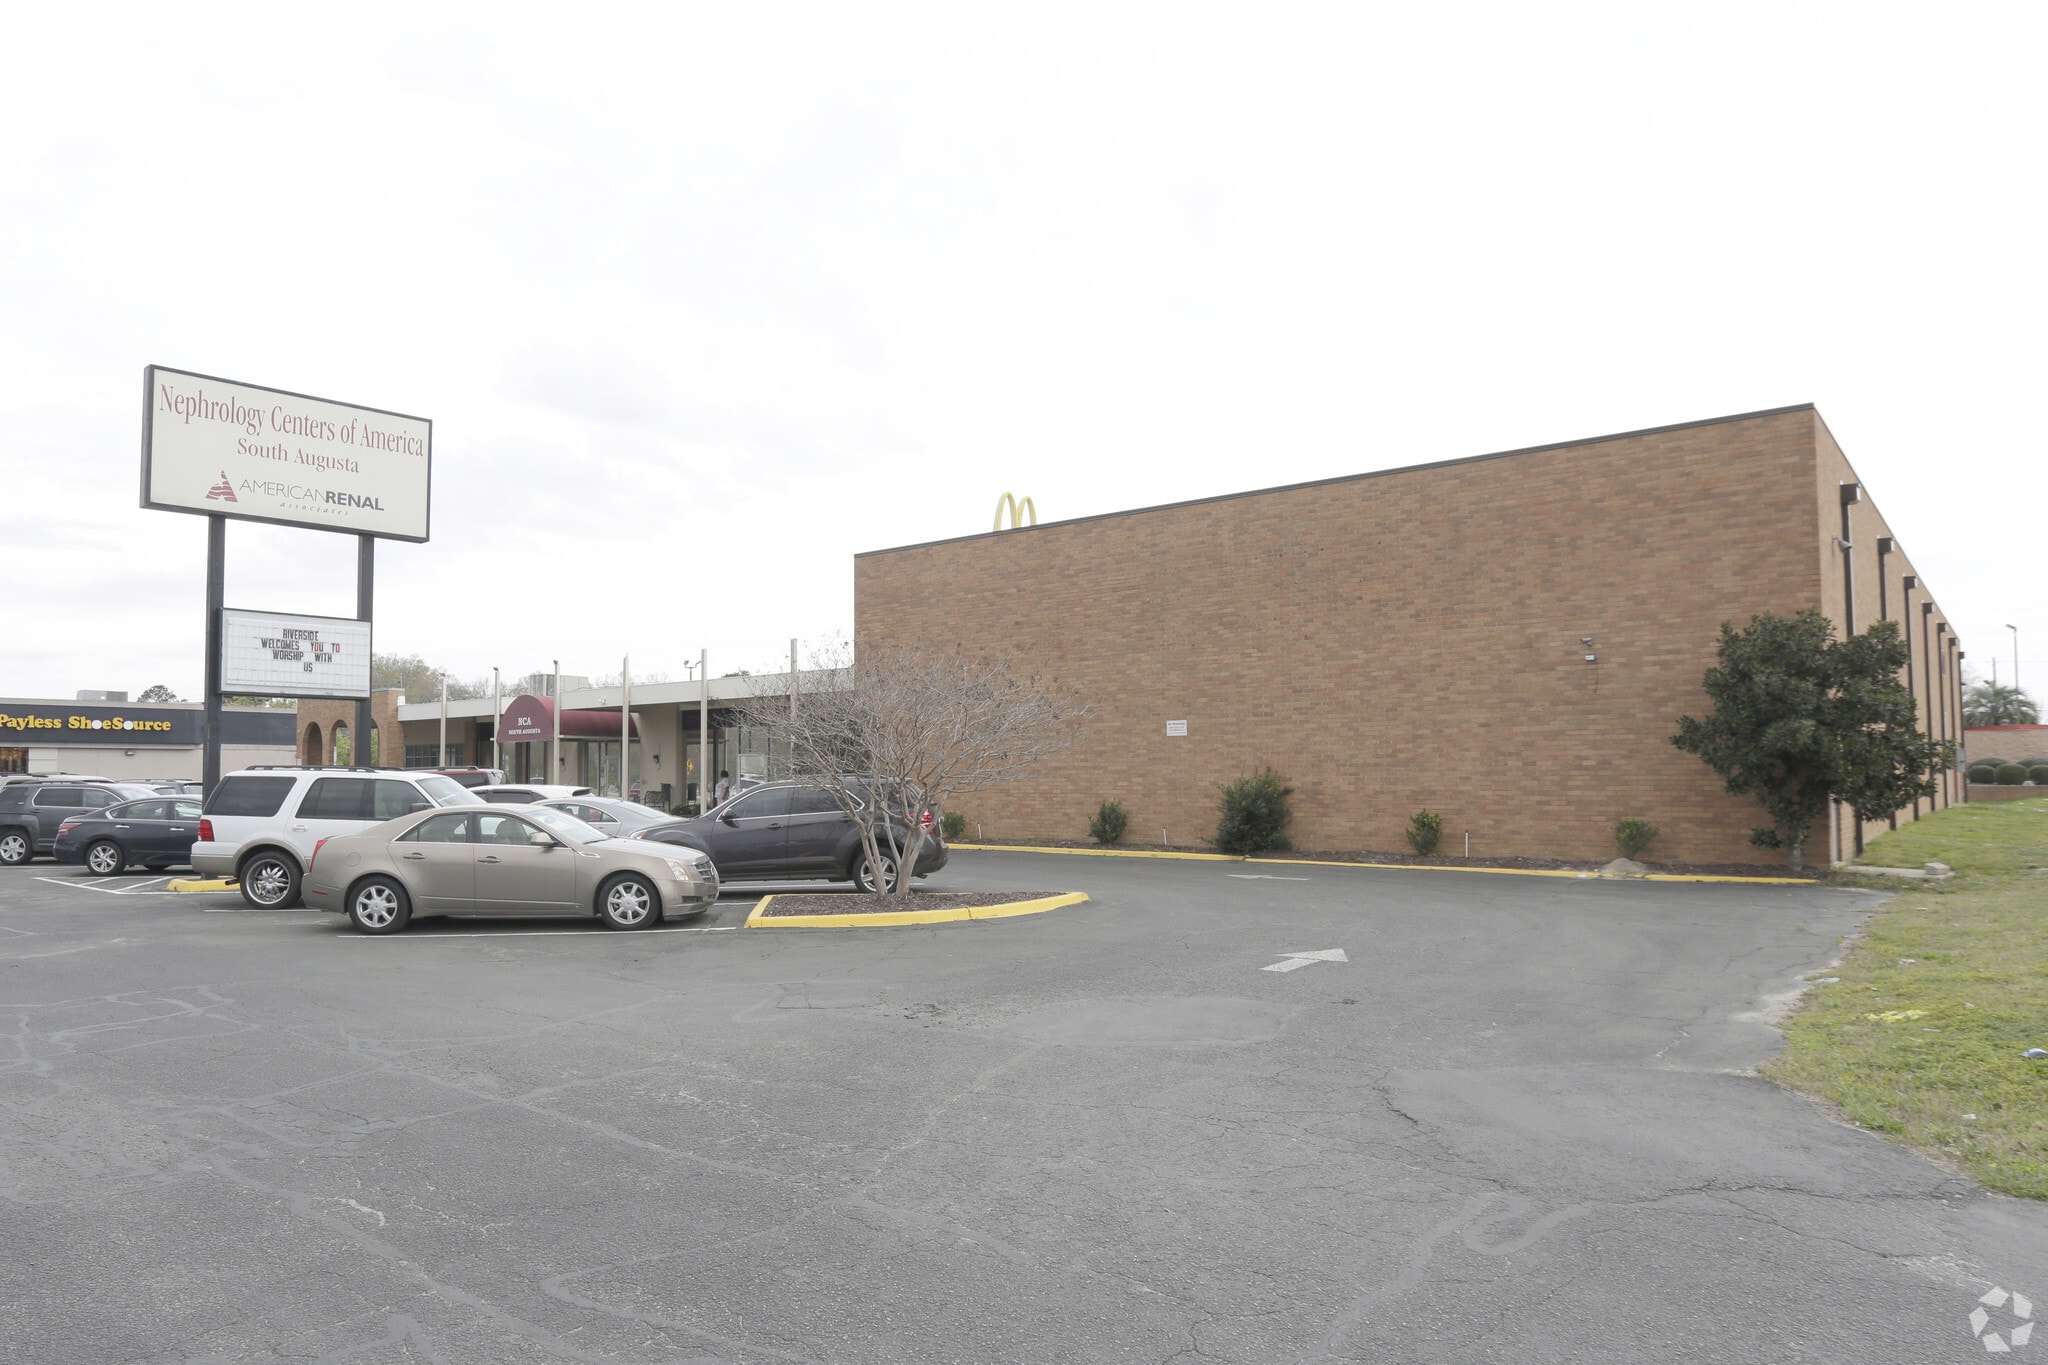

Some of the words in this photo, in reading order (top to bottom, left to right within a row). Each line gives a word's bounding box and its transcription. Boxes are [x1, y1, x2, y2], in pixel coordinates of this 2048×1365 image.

[159, 383, 266, 437] Nephrology
[271, 406, 335, 441] Centers
[340, 417, 358, 444] of
[360, 423, 424, 457] America
[237, 437, 288, 462] South
[294, 448, 360, 474] Augusta
[283, 629, 319, 641] RIVERSIDE
[261, 639, 300, 650] WELCOMES
[310, 642, 324, 652] YOU
[331, 643, 340, 653] TO
[272, 651, 304, 661] WORSHIP
[314, 652, 333, 663] WITH
[303, 662, 313, 672] US
[0, 714, 61, 730] Payless
[68, 716, 172, 731] ShoeSource
[518, 717, 531, 726] NCA
